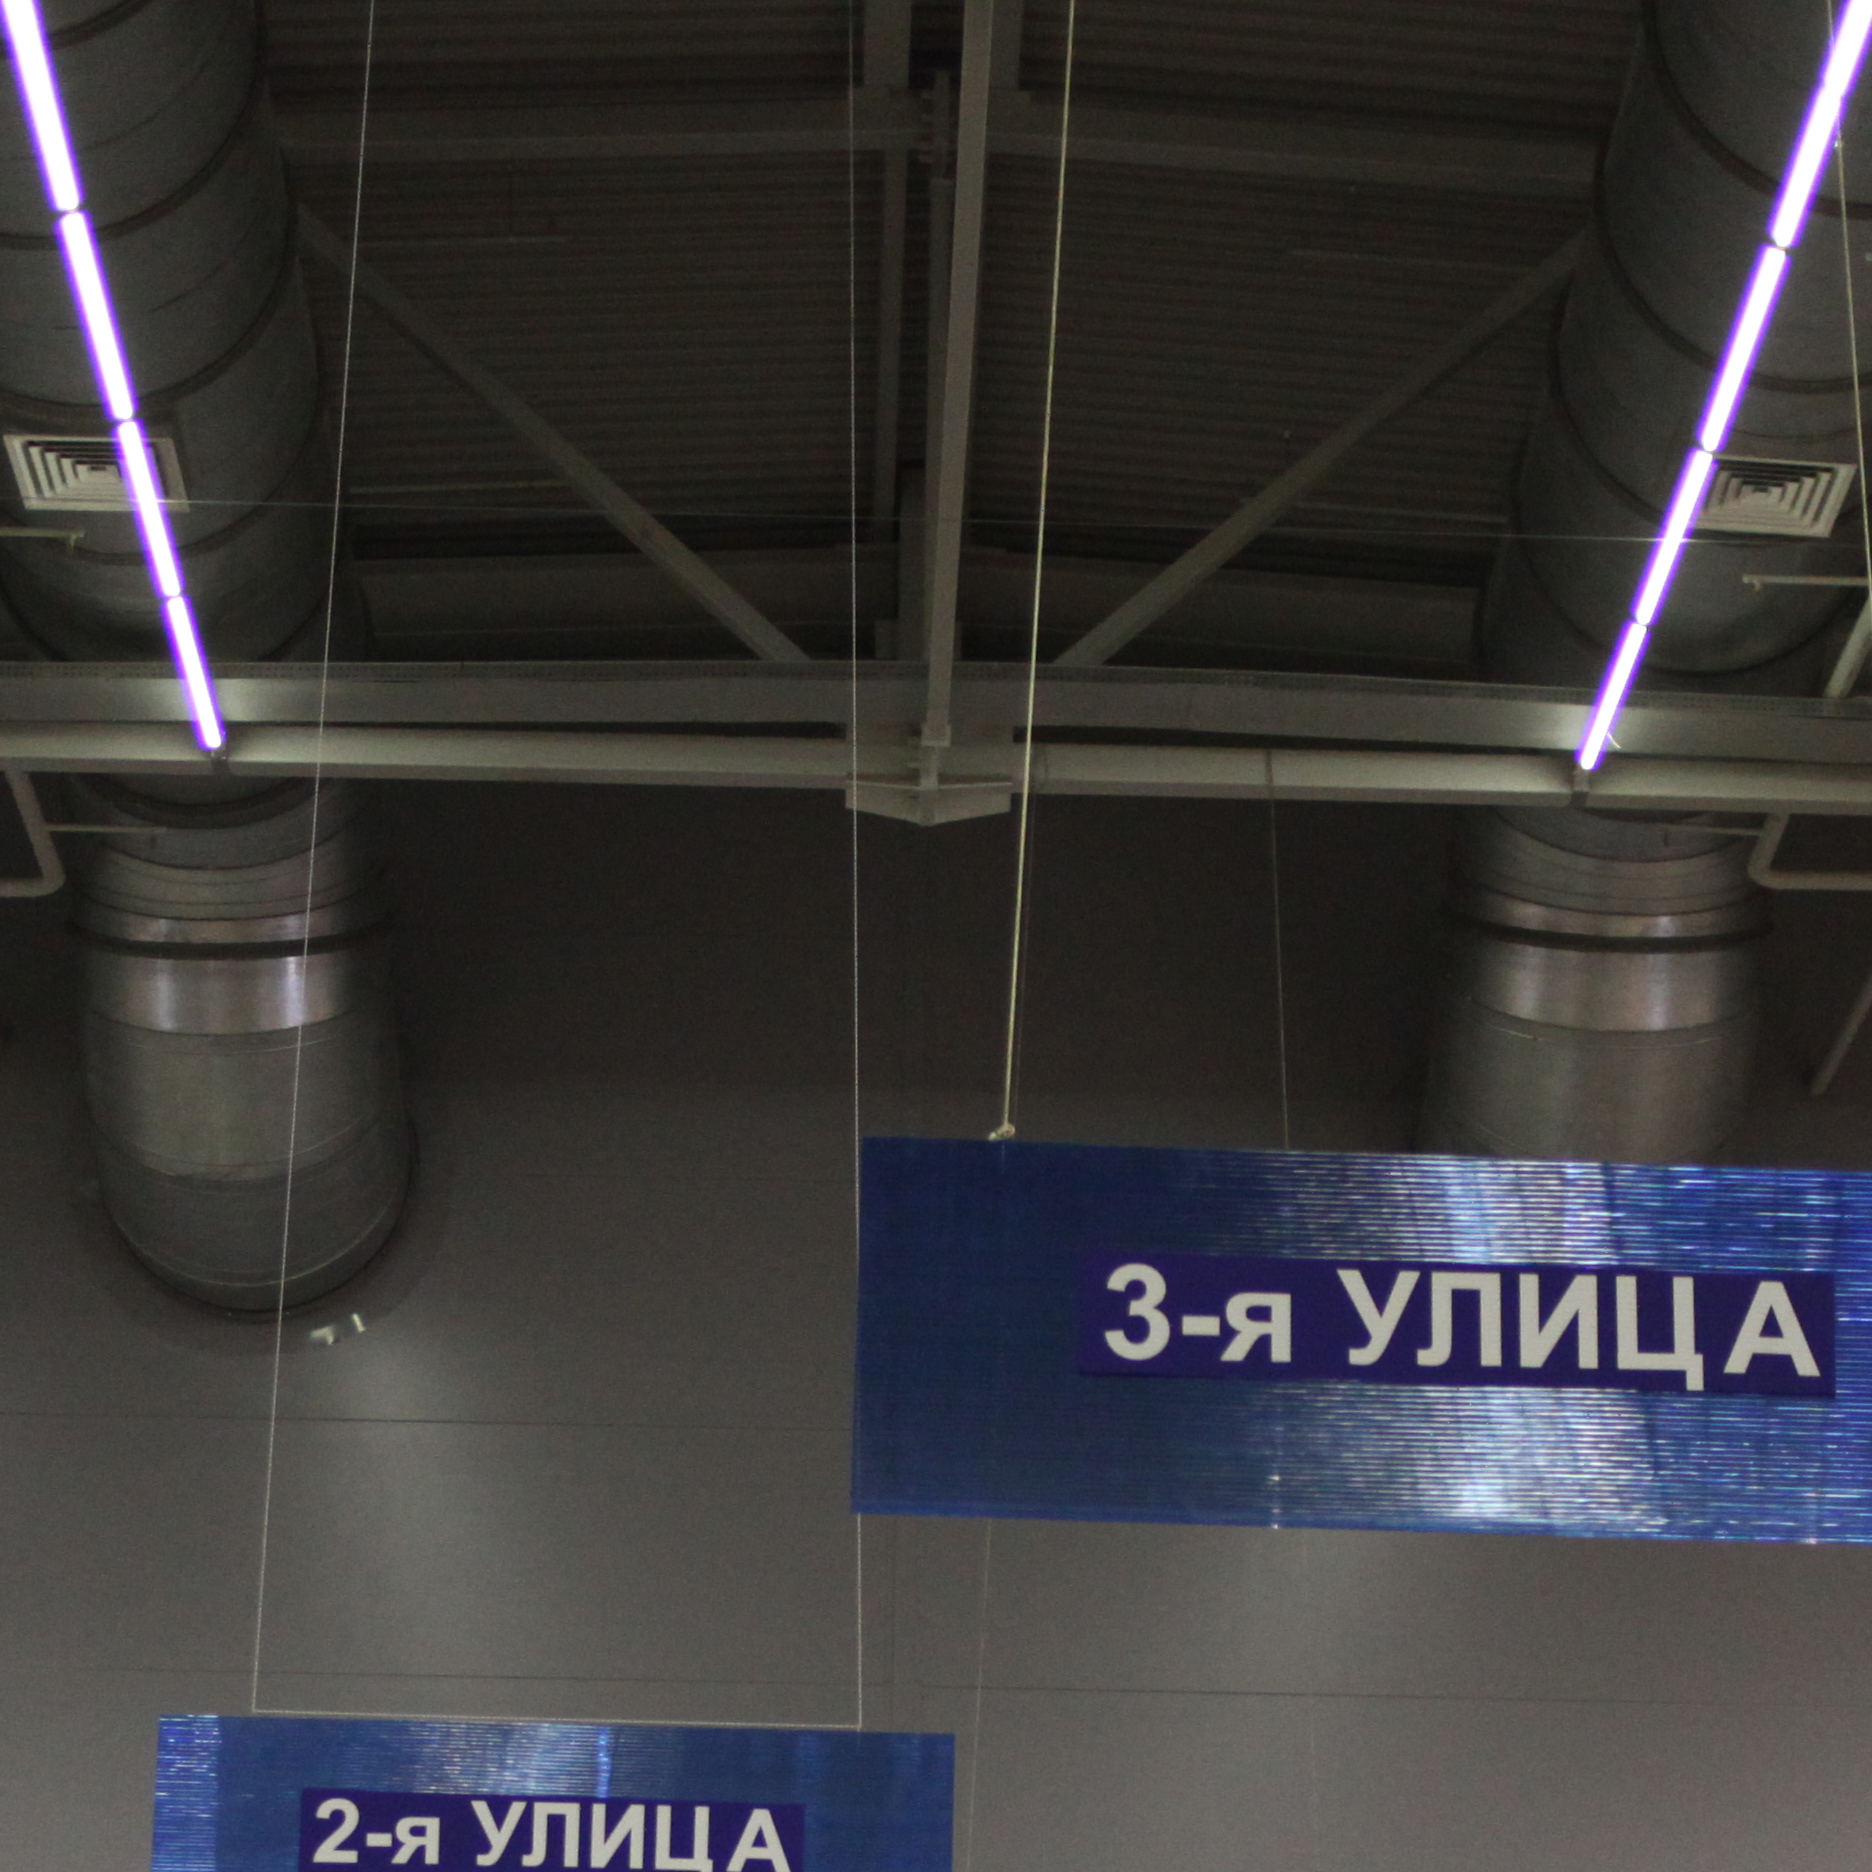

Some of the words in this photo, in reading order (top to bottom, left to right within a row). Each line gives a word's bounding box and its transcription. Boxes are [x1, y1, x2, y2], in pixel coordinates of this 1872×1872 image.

[1104, 1263, 1293, 1363] 3-я
[1336, 1267, 1820, 1392] УЛИЦА
[312, 1797, 441, 1866] 2-я
